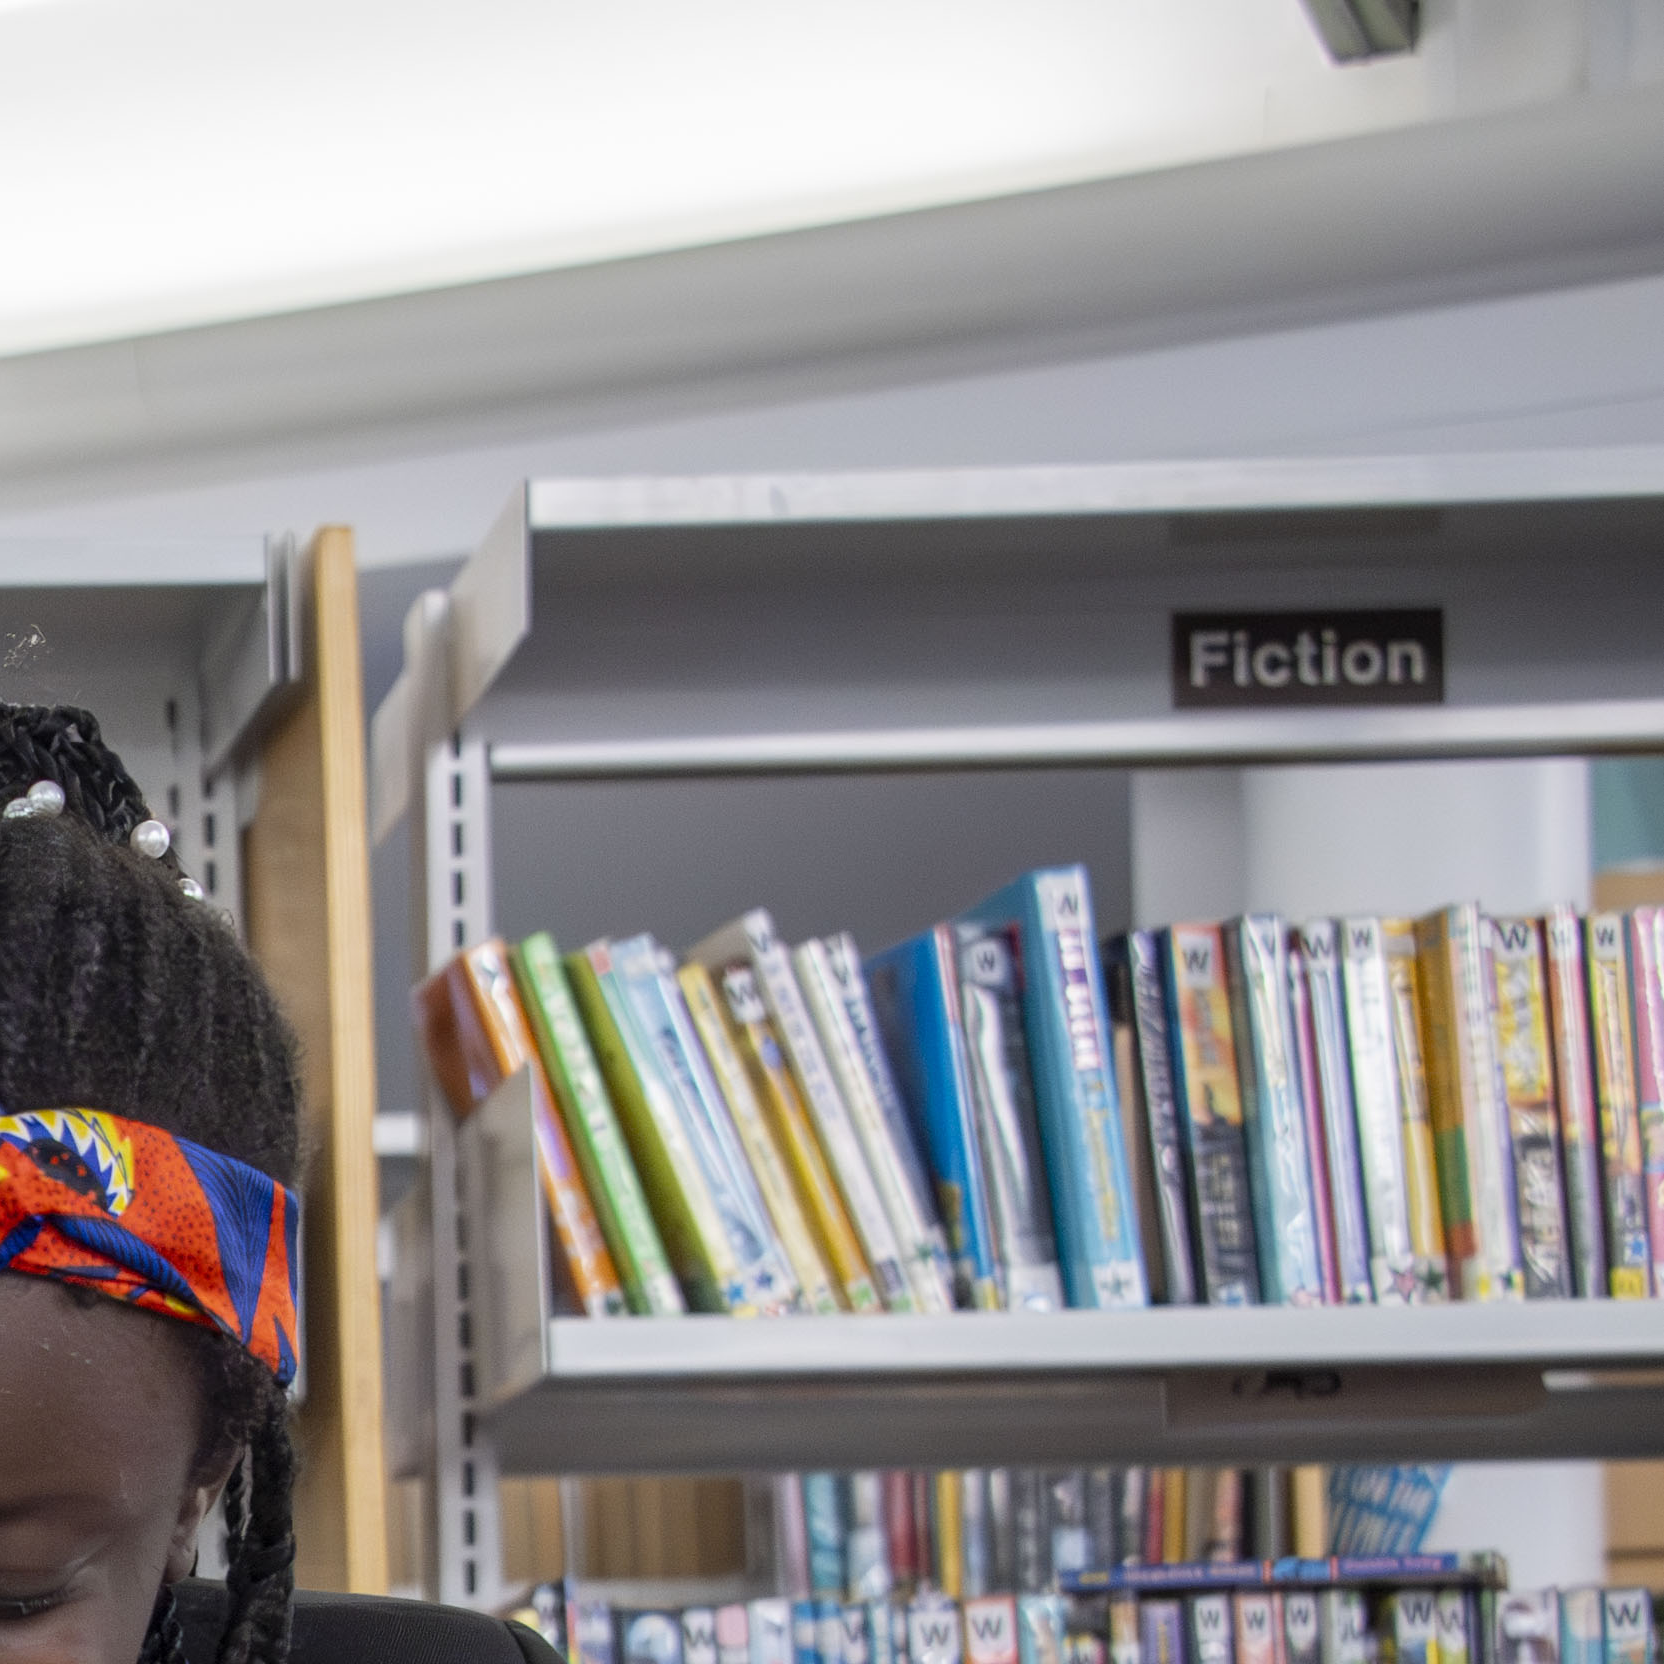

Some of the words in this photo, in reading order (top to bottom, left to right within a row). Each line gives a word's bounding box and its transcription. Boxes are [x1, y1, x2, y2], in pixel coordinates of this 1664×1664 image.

[1187, 629, 1427, 688] Fiction
[1351, 927, 1372, 948] W
[1493, 922, 1531, 951] W
[1594, 926, 1616, 947] W
[977, 950, 997, 972] W
[1183, 948, 1210, 974] W
[1199, 1608, 1221, 1631] W
[1245, 1609, 1266, 1631] W
[1289, 1604, 1311, 1627] W
[1400, 1603, 1434, 1629] W
[1610, 1603, 1642, 1629] W
[684, 1622, 714, 1647] W
[920, 1622, 950, 1648] W
[973, 1616, 1002, 1641] W
